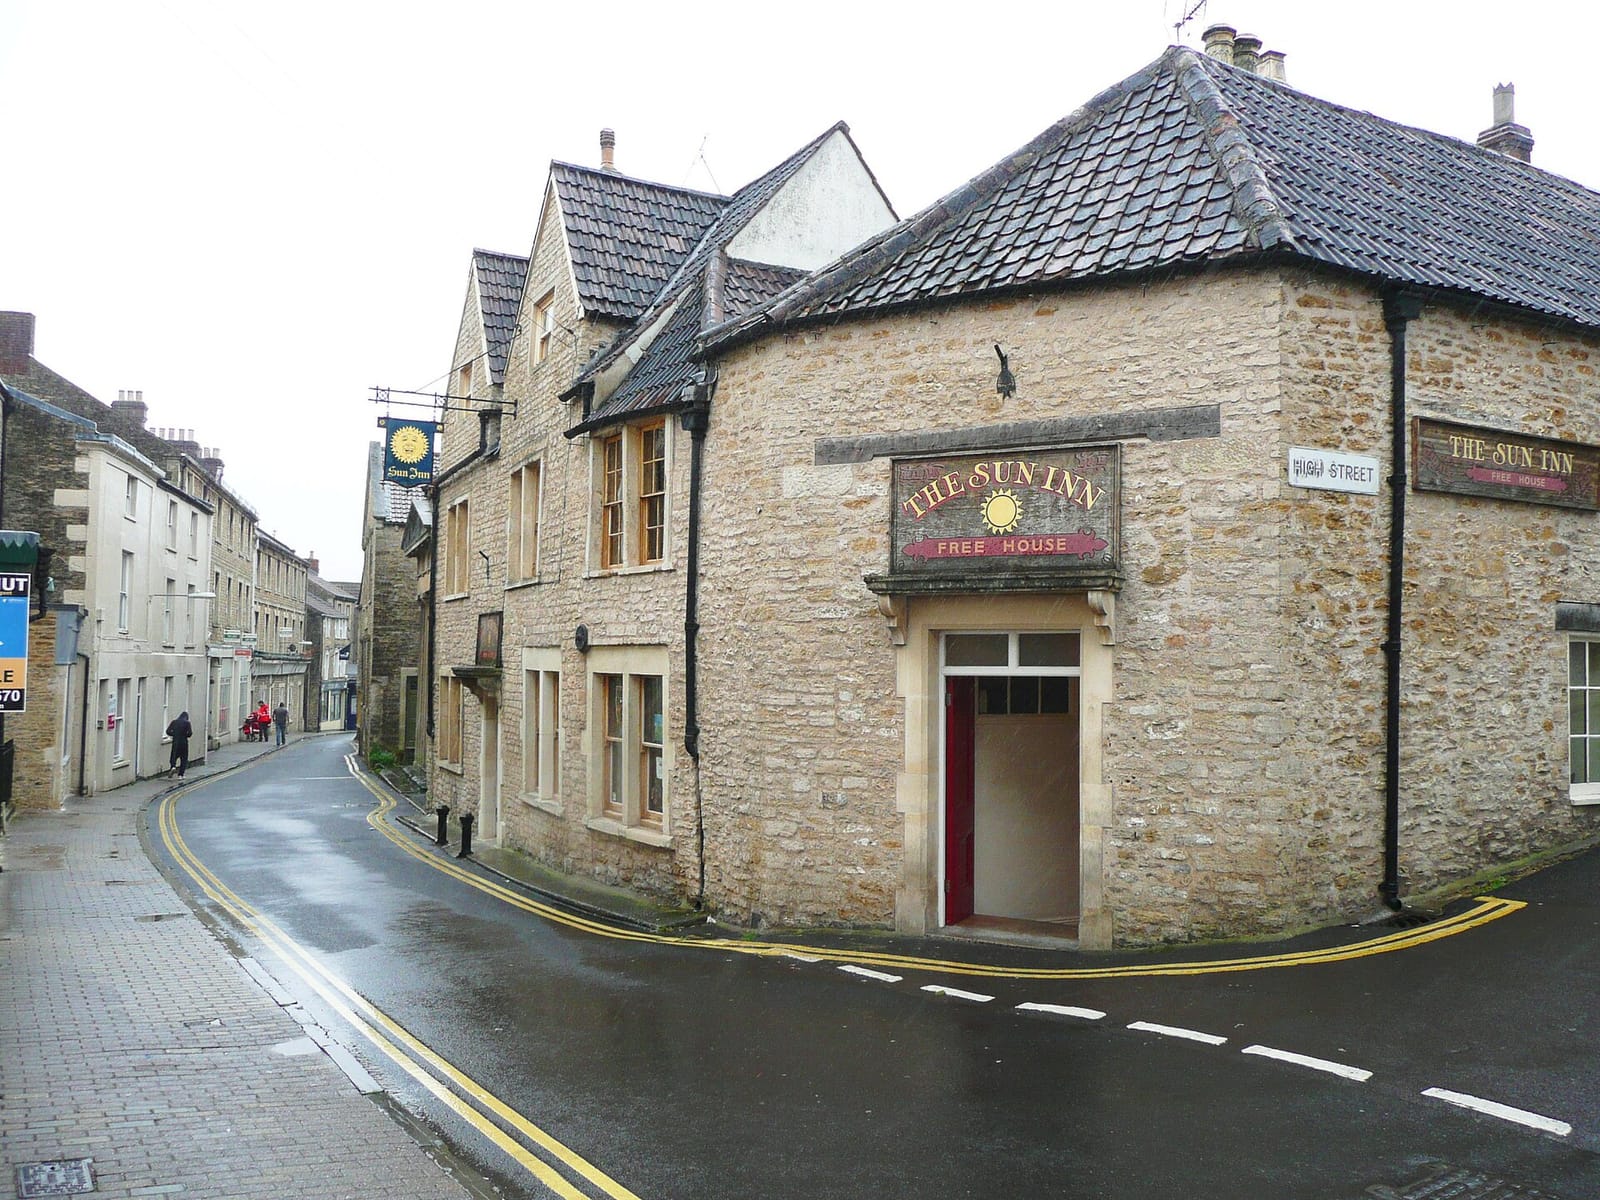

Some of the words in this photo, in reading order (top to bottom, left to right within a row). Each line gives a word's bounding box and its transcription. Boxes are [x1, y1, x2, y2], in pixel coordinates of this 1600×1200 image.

[1450, 435, 1485, 461] THE
[1493, 443, 1534, 468] SUN
[1541, 449, 1575, 474] INN
[387, 465, 408, 478] Sun
[409, 467, 430, 479] Inn
[1293, 458, 1324, 478] HIGH
[1329, 462, 1374, 483] STREET
[1491, 471, 1512, 483] FREE
[1518, 475, 1546, 488] HOUSE
[902, 471, 965, 519] THE
[968, 461, 1039, 488] SUN
[1040, 465, 1106, 510] INN
[938, 541, 985, 555] FREE
[1003, 538, 1067, 553] HOUSE
[0, 578, 28, 592] UT
